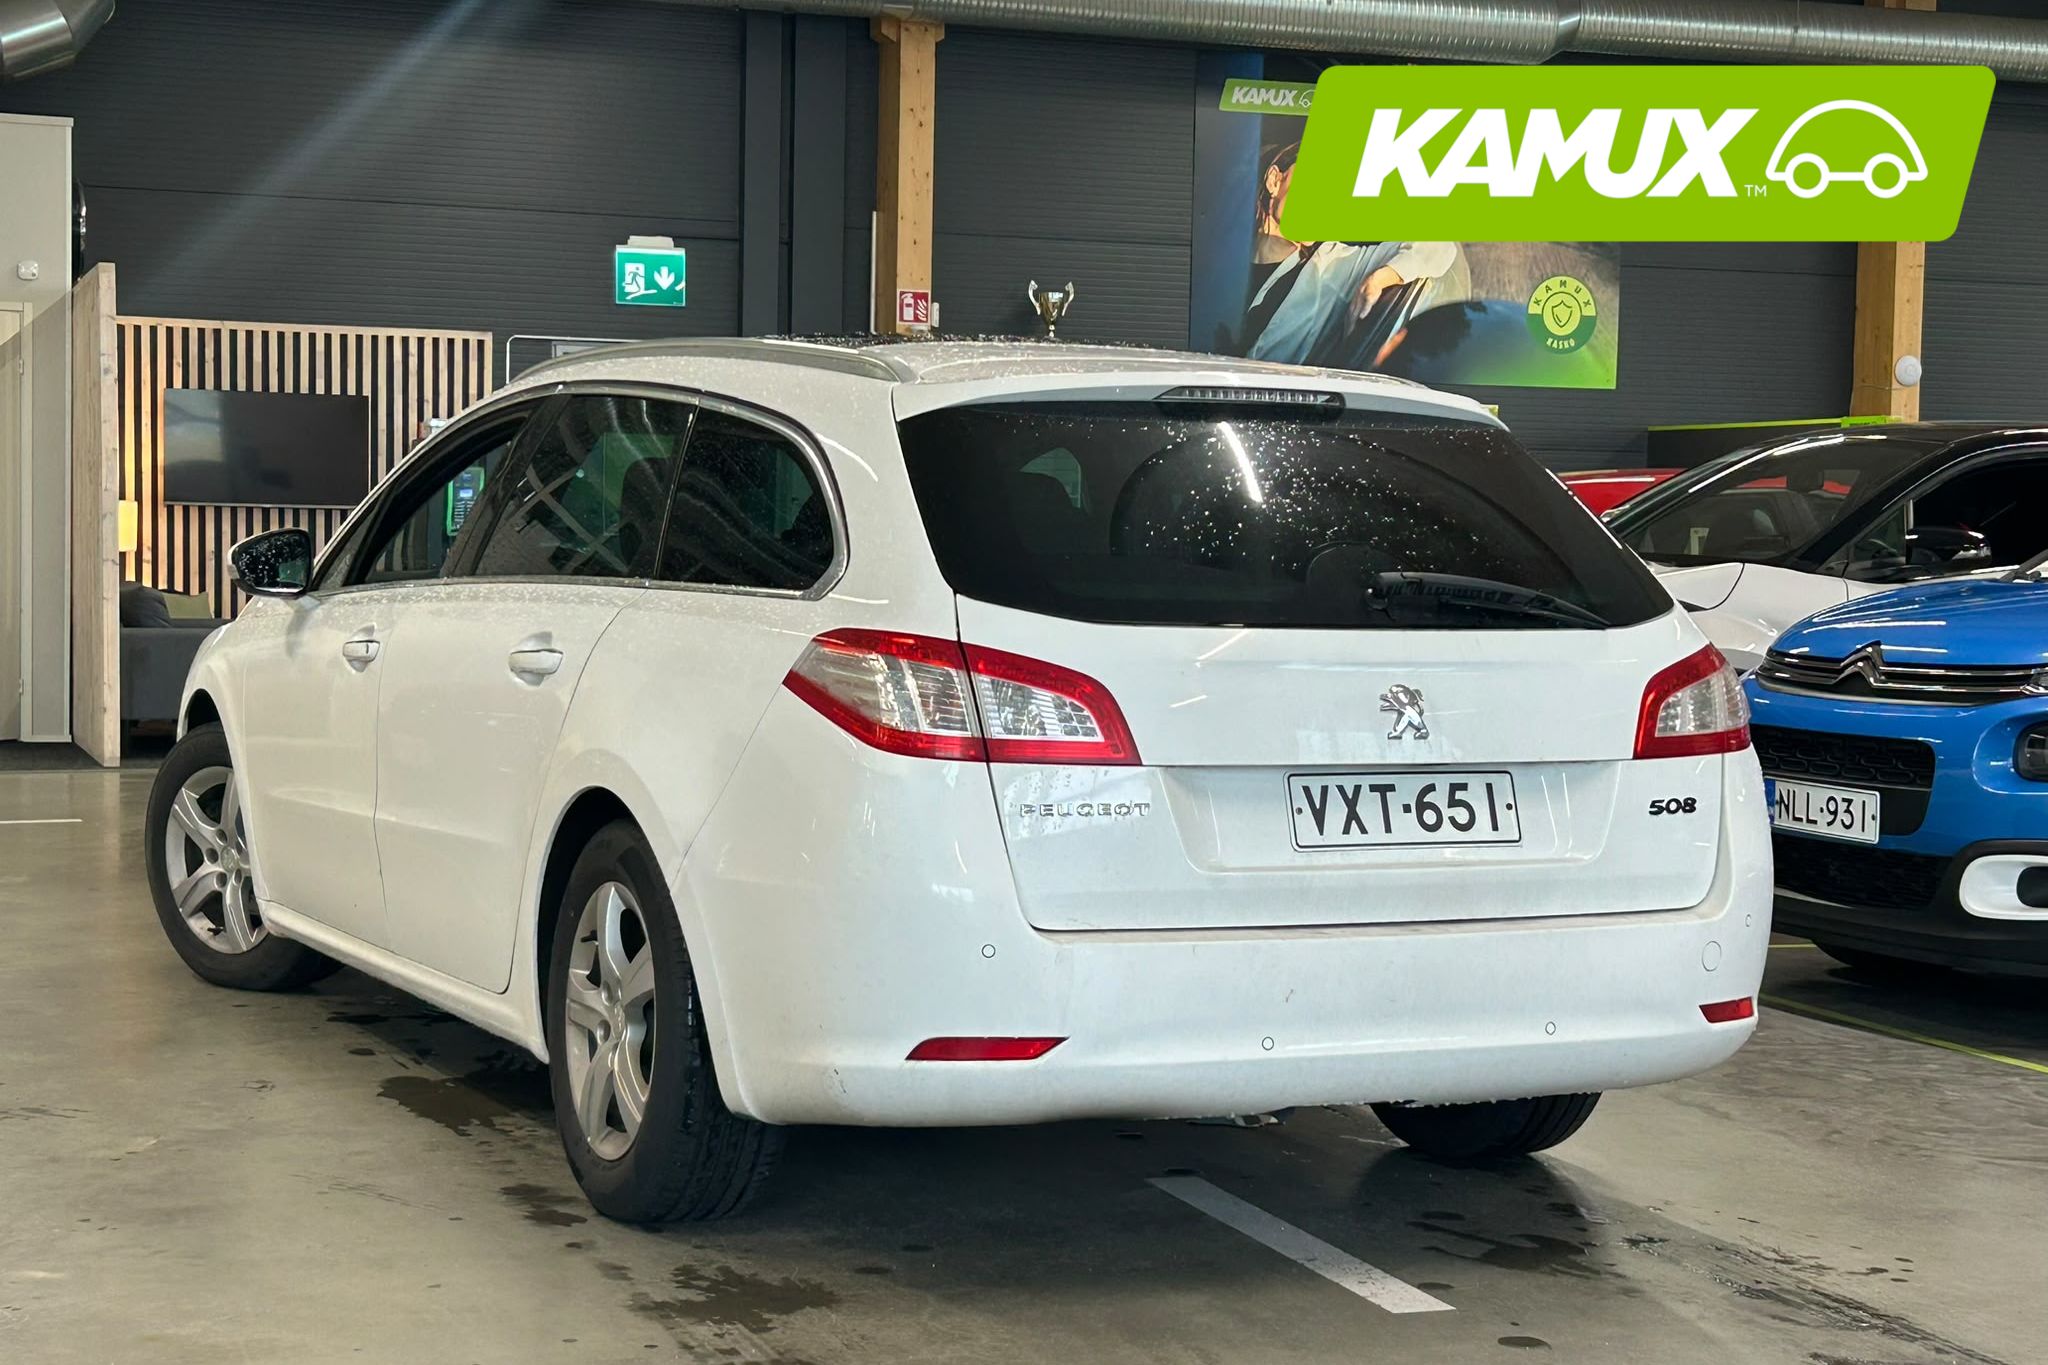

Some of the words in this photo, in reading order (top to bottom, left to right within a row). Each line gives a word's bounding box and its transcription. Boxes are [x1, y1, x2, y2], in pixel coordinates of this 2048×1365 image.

[1231, 86, 1298, 107] KAMUX
[1533, 279, 1592, 308] KAMUX
[1546, 337, 1576, 350] KASKO
[1019, 802, 1151, 818] PEUGEOT
[1301, 782, 1499, 836] VXT-651
[1648, 796, 1698, 816] 508
[1778, 787, 1867, 834] NLL-931
